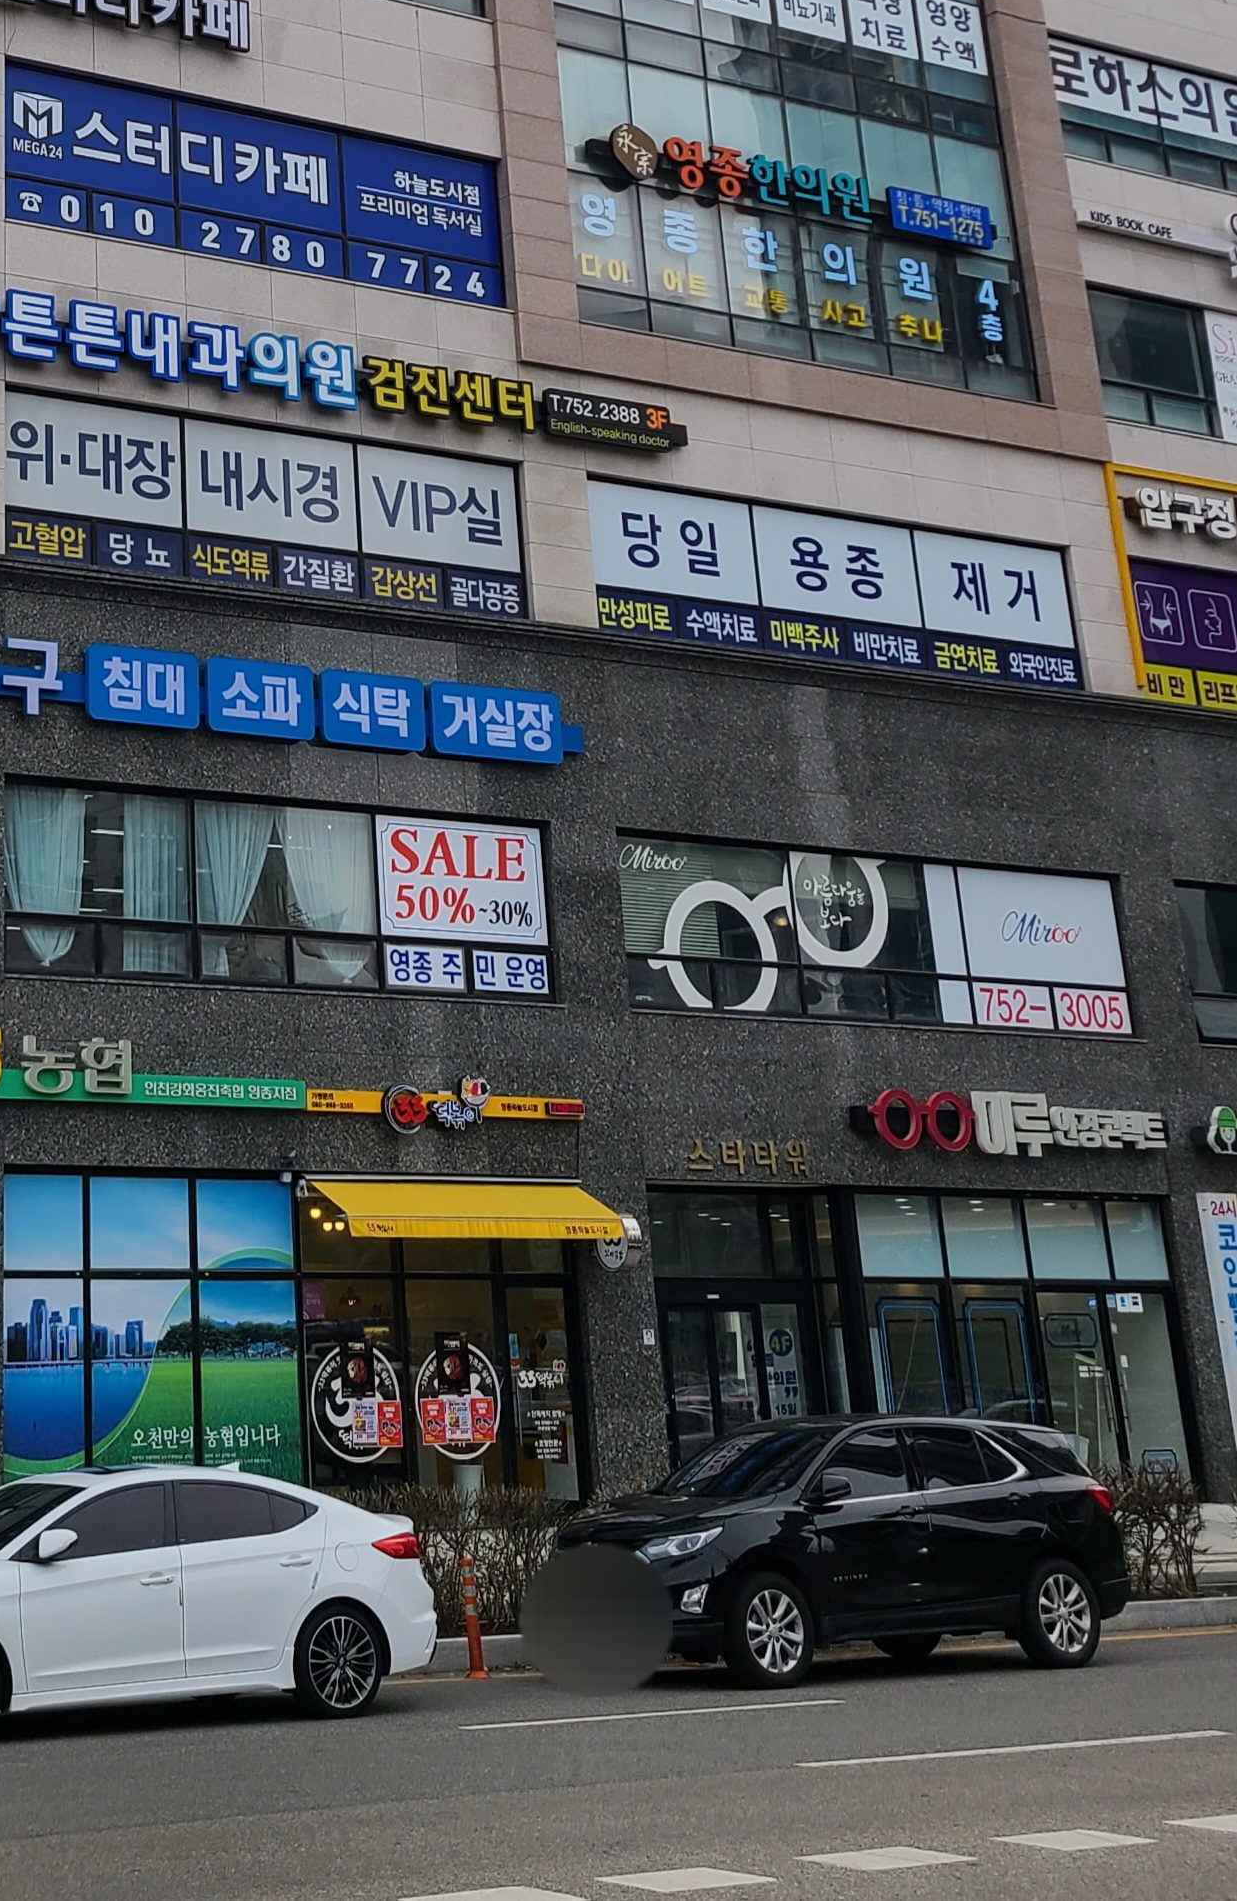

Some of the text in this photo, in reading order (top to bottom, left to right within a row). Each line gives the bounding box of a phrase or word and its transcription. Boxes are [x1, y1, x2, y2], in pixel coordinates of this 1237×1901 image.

[860, 17, 909, 52] 치료
[930, 35, 978, 71] 수액
[12, 136, 65, 161] MEGA24
[71, 110, 330, 206] 스터디카페
[393, 169, 481, 208] 하늘도시점
[663, 136, 874, 225] 영종한의원
[59, 194, 326, 268] 010 2780
[359, 193, 483, 238] 프리미엄 독서실
[896, 204, 985, 239] T.751-1275
[1090, 210, 1173, 240] KIDS BOOK CAFE
[898, 312, 943, 344] 추나
[363, 356, 536, 434] 검진센터
[549, 393, 668, 430] T.752.2388 3F
[551, 418, 671, 448] English-speaking doctor
[200, 449, 340, 524] 내시경
[371, 475, 504, 547] VIP실
[8, 518, 87, 560] 고혈압
[192, 546, 271, 583] 식도역류
[282, 553, 356, 595] 간질환
[620, 511, 1042, 624] 당일 용종 제거
[371, 565, 438, 604] 갑상선
[450, 577, 521, 615] 골다공증
[598, 596, 674, 634] 만성피로
[685, 609, 759, 645] 수액치료
[769, 619, 840, 658] 미백주사
[852, 629, 922, 667] 비만치료
[933, 639, 1001, 675] 금연치료
[1008, 650, 1079, 685] 외국인진료
[1146, 672, 1186, 699] 비만
[100, 656, 554, 754] 침대 소파 식탁 거실장
[389, 827, 527, 883] SALE
[618, 842, 689, 874] Miroo
[801, 874, 866, 908] 아름다움을
[817, 908, 853, 931] 보다
[1000, 909, 1084, 947] Miroo
[389, 948, 547, 991] 영종 주민 운영
[19, 1033, 134, 1097] 농협
[688, 1138, 811, 1179] 스타타워
[770, 1333, 792, 1353] 4F
[130, 1422, 281, 1450] 오천만의 농협입니다
